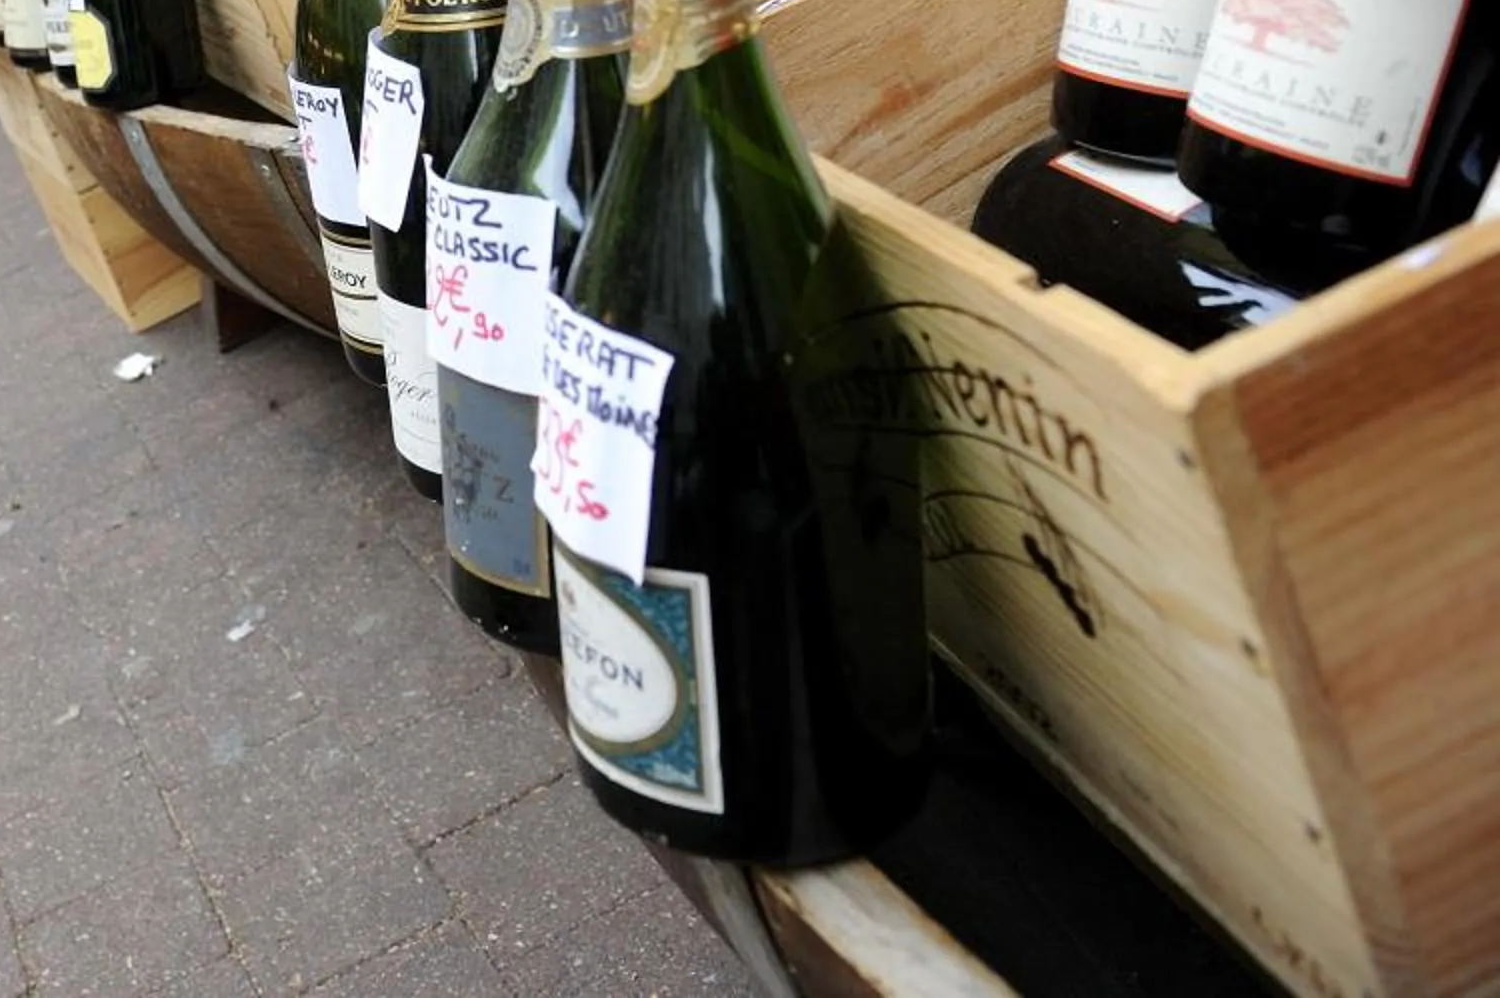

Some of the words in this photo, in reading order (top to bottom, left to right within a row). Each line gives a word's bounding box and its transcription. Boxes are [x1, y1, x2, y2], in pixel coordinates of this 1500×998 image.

[296, 89, 339, 119] EROY
[427, 185, 504, 229] EUTZ
[434, 223, 538, 272] CLASSIC
[330, 265, 368, 289] EROY
